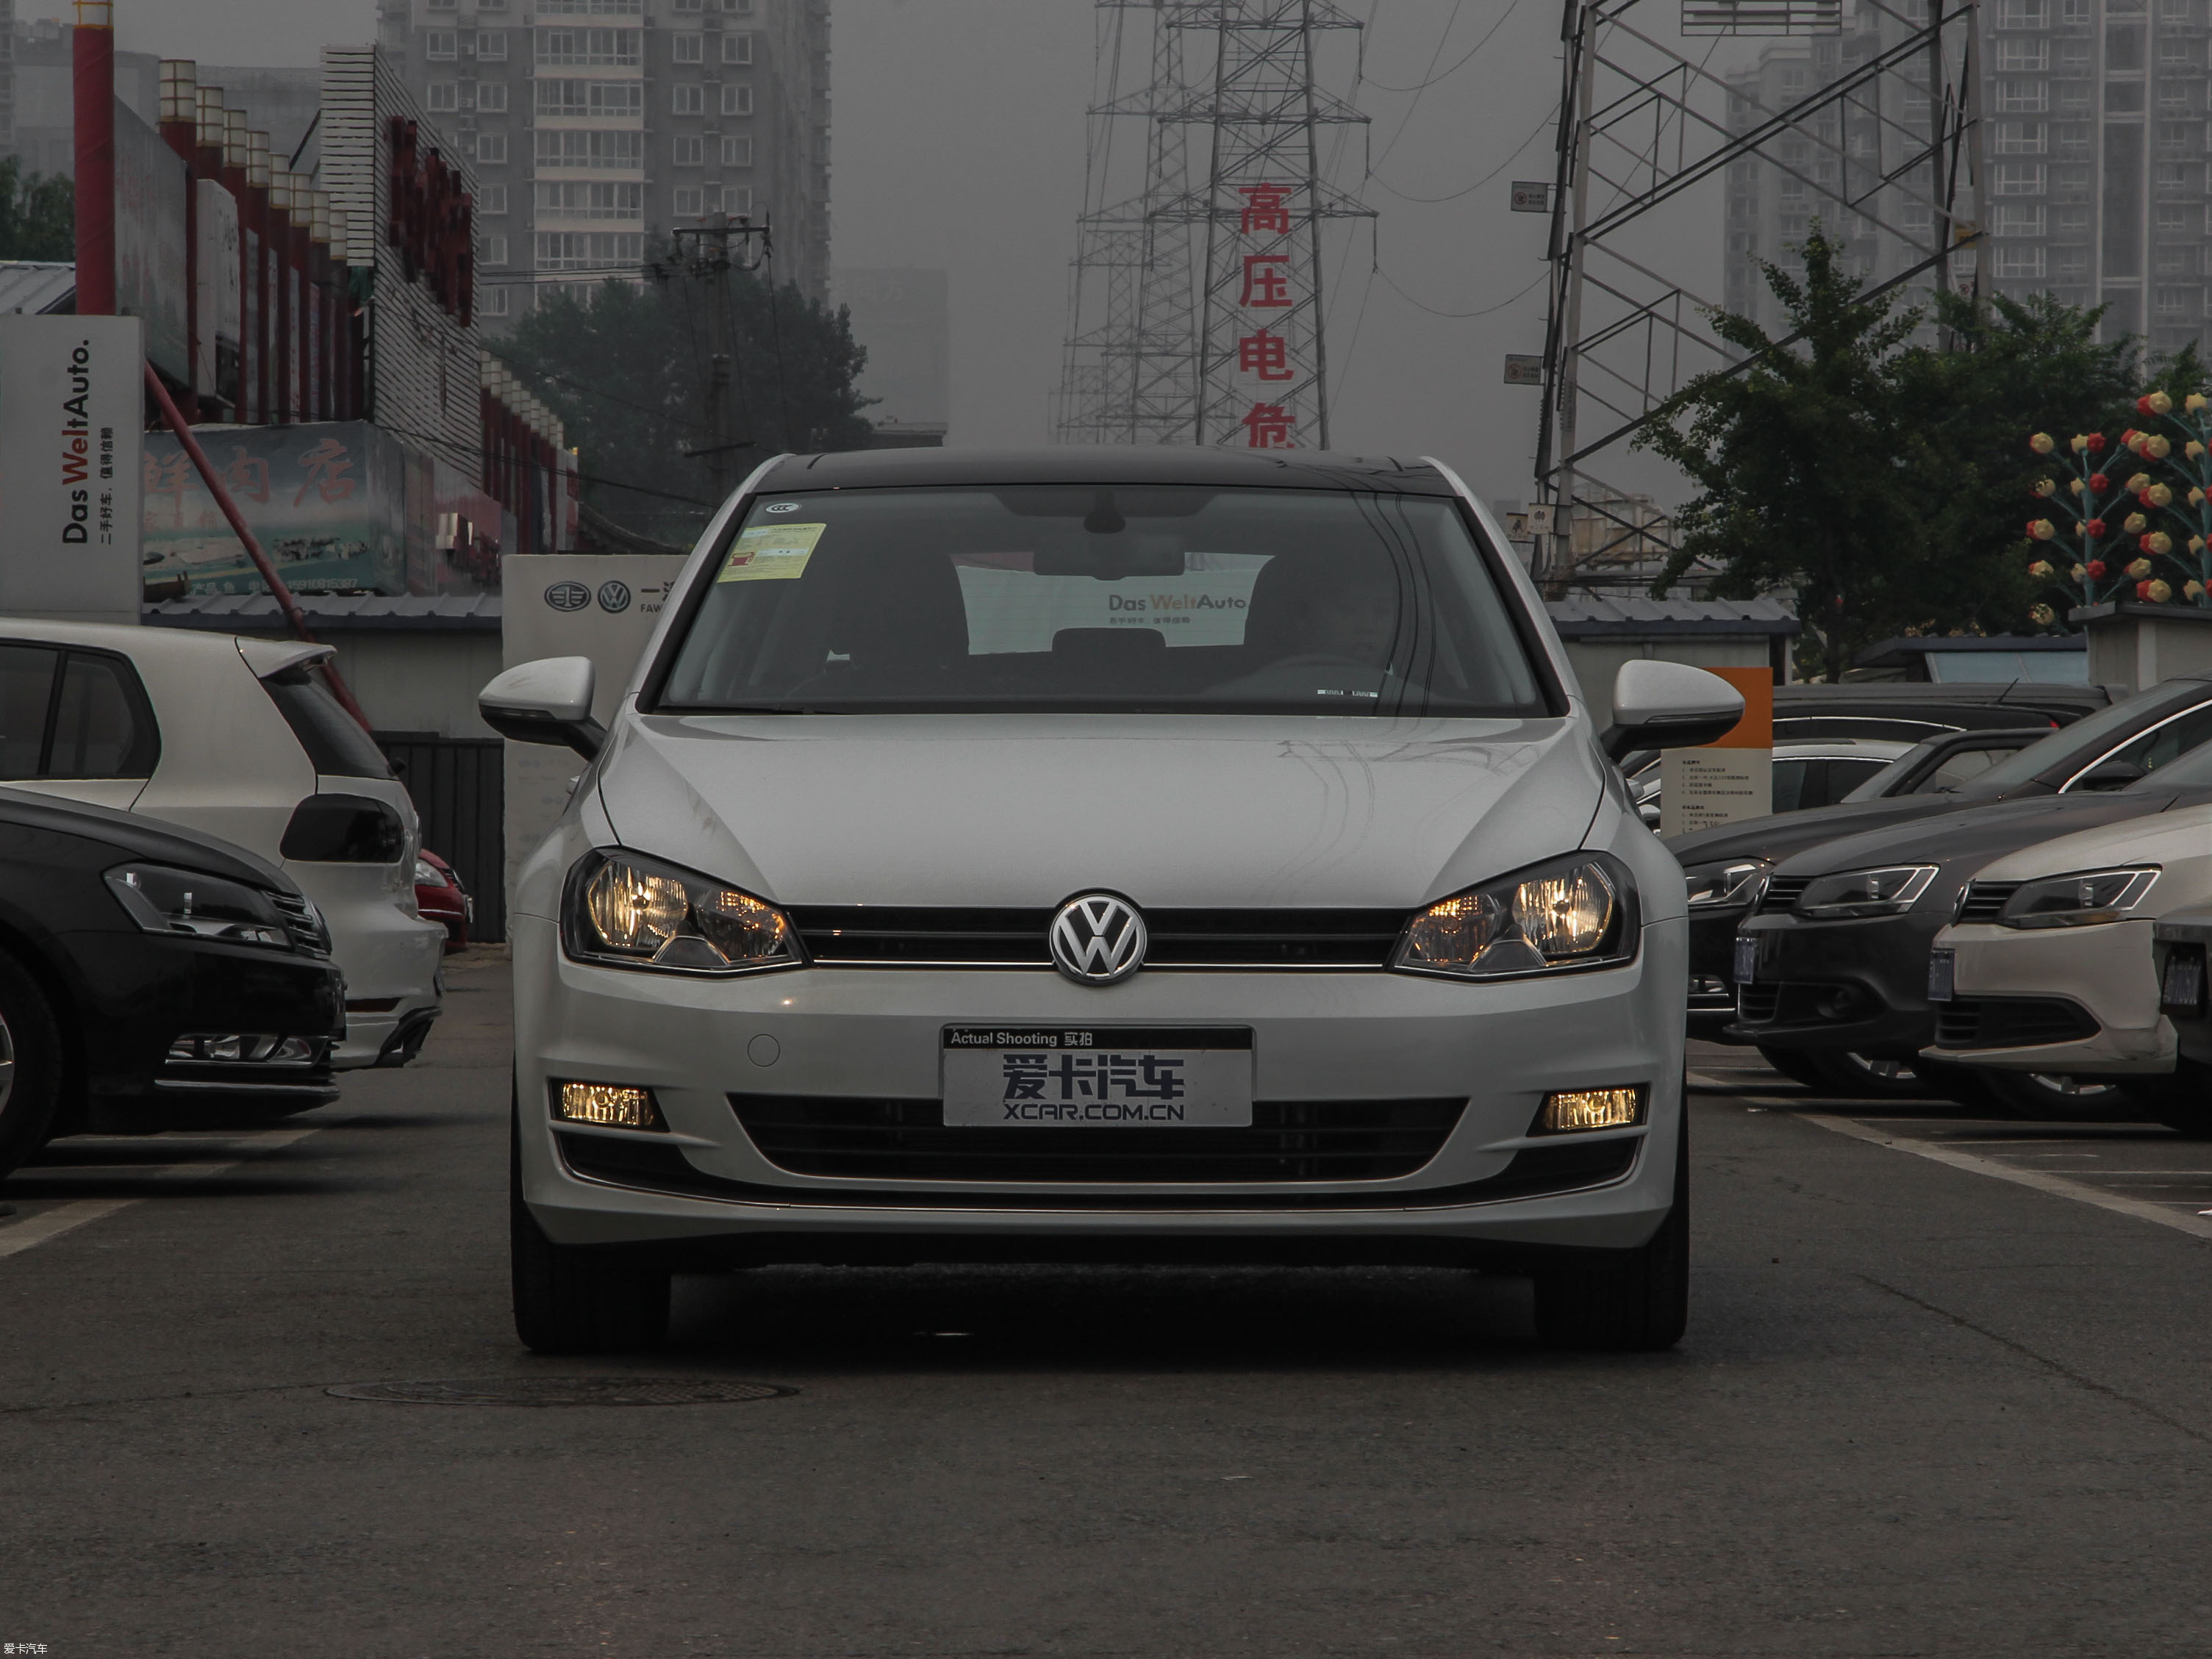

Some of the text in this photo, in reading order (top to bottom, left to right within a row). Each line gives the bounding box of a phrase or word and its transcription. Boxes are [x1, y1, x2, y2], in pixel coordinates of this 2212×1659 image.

[1238, 182, 1296, 449] 高压电危
[62, 339, 90, 544] Das WeltAuto.
[1109, 594, 1147, 612] Das
[950, 1031, 1093, 1047] Actual Shooting 实拍
[1003, 1054, 1185, 1100] 爱卡汽车
[1003, 1103, 1185, 1121] XCAR.COM.CN
